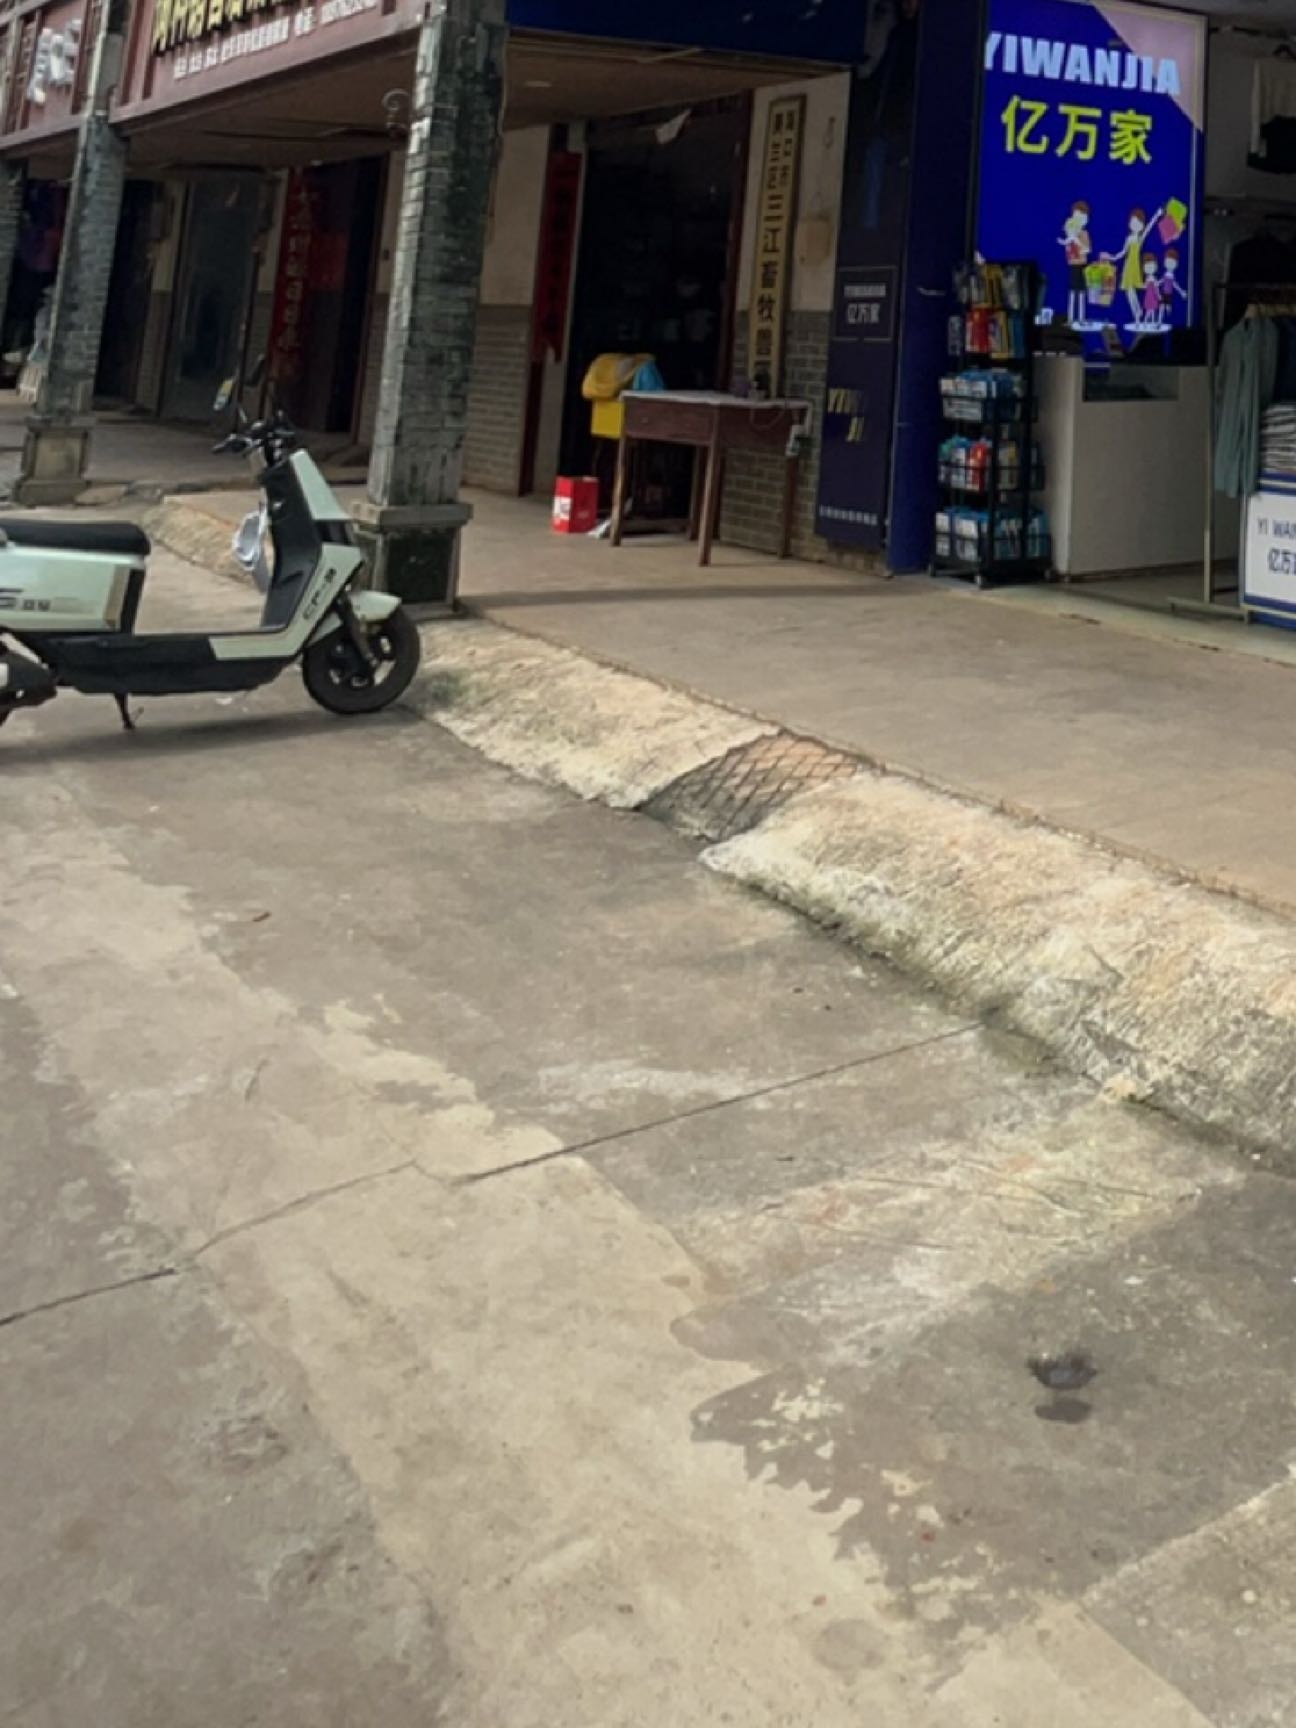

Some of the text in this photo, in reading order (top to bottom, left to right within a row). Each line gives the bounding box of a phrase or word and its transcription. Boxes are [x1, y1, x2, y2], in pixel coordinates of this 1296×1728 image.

[984, 31, 1181, 96] YIWANJIA
[1001, 94, 1152, 165] 亿万家
[754, 194, 784, 367] 三江畜牧兽
[1257, 518, 1269, 536] YI
